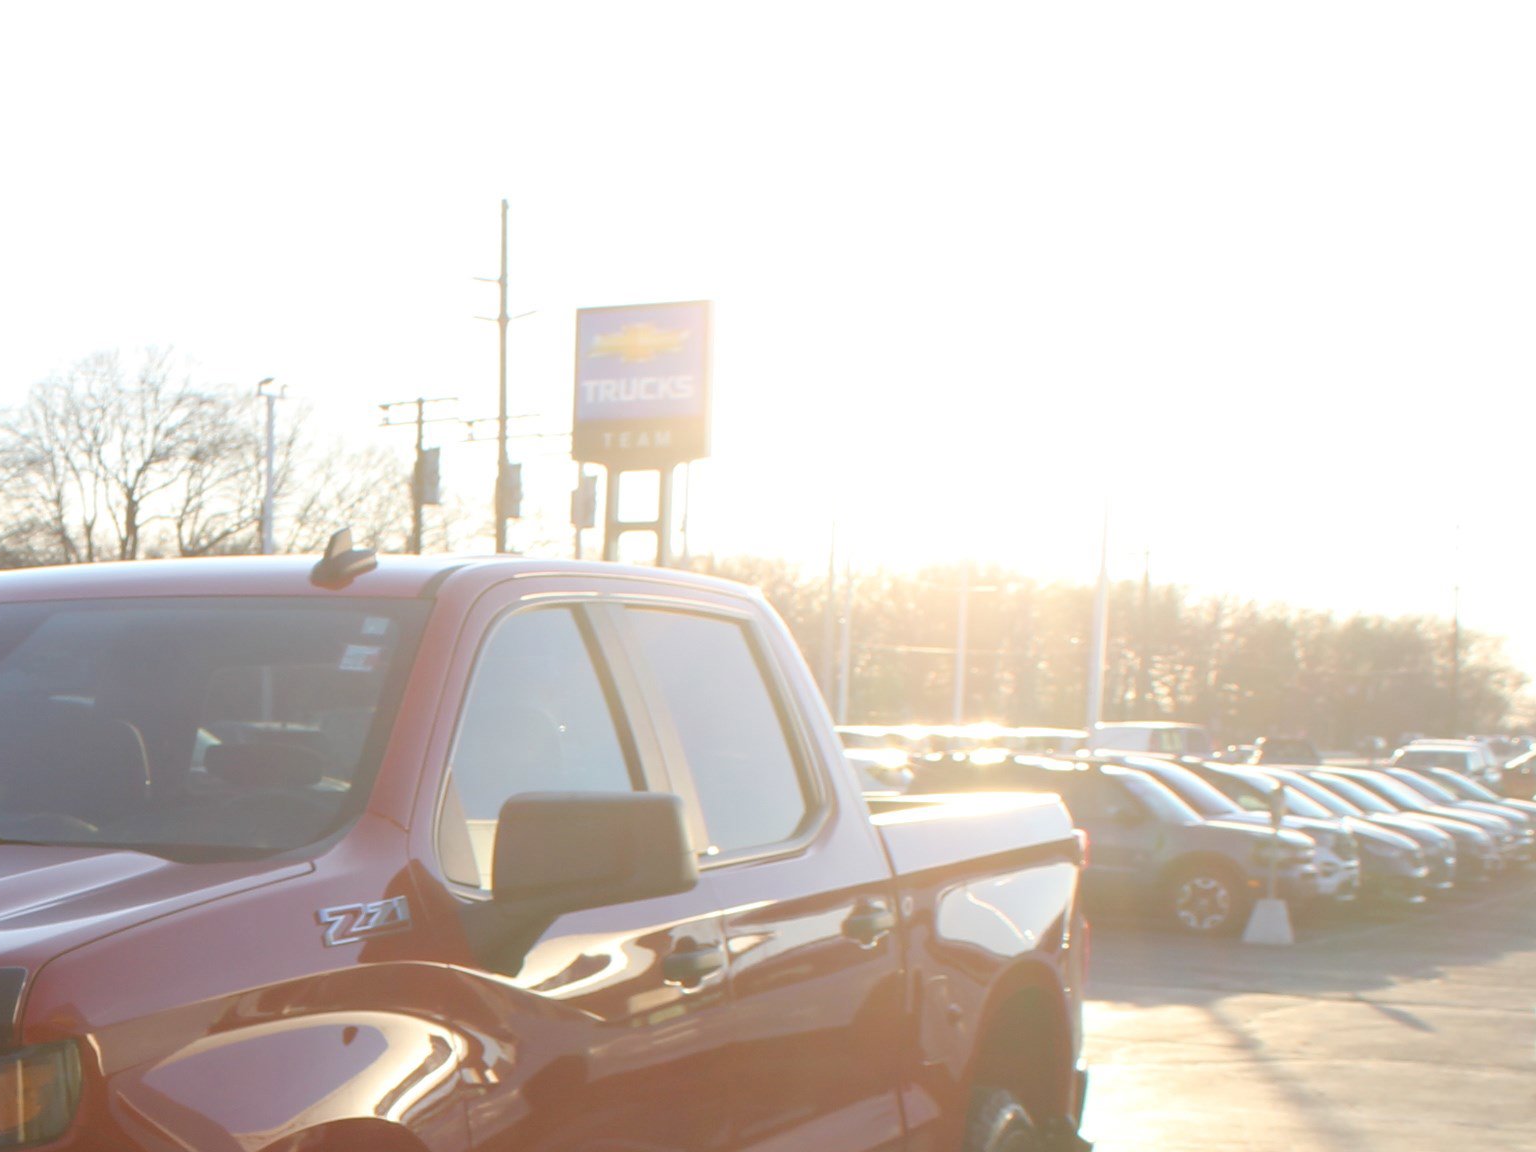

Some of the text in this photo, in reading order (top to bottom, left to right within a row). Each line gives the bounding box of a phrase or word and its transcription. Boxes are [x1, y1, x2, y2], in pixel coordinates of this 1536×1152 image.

[582, 375, 694, 402] TRUCKS
[602, 431, 670, 448] TEAM
[319, 895, 410, 946] Z71
